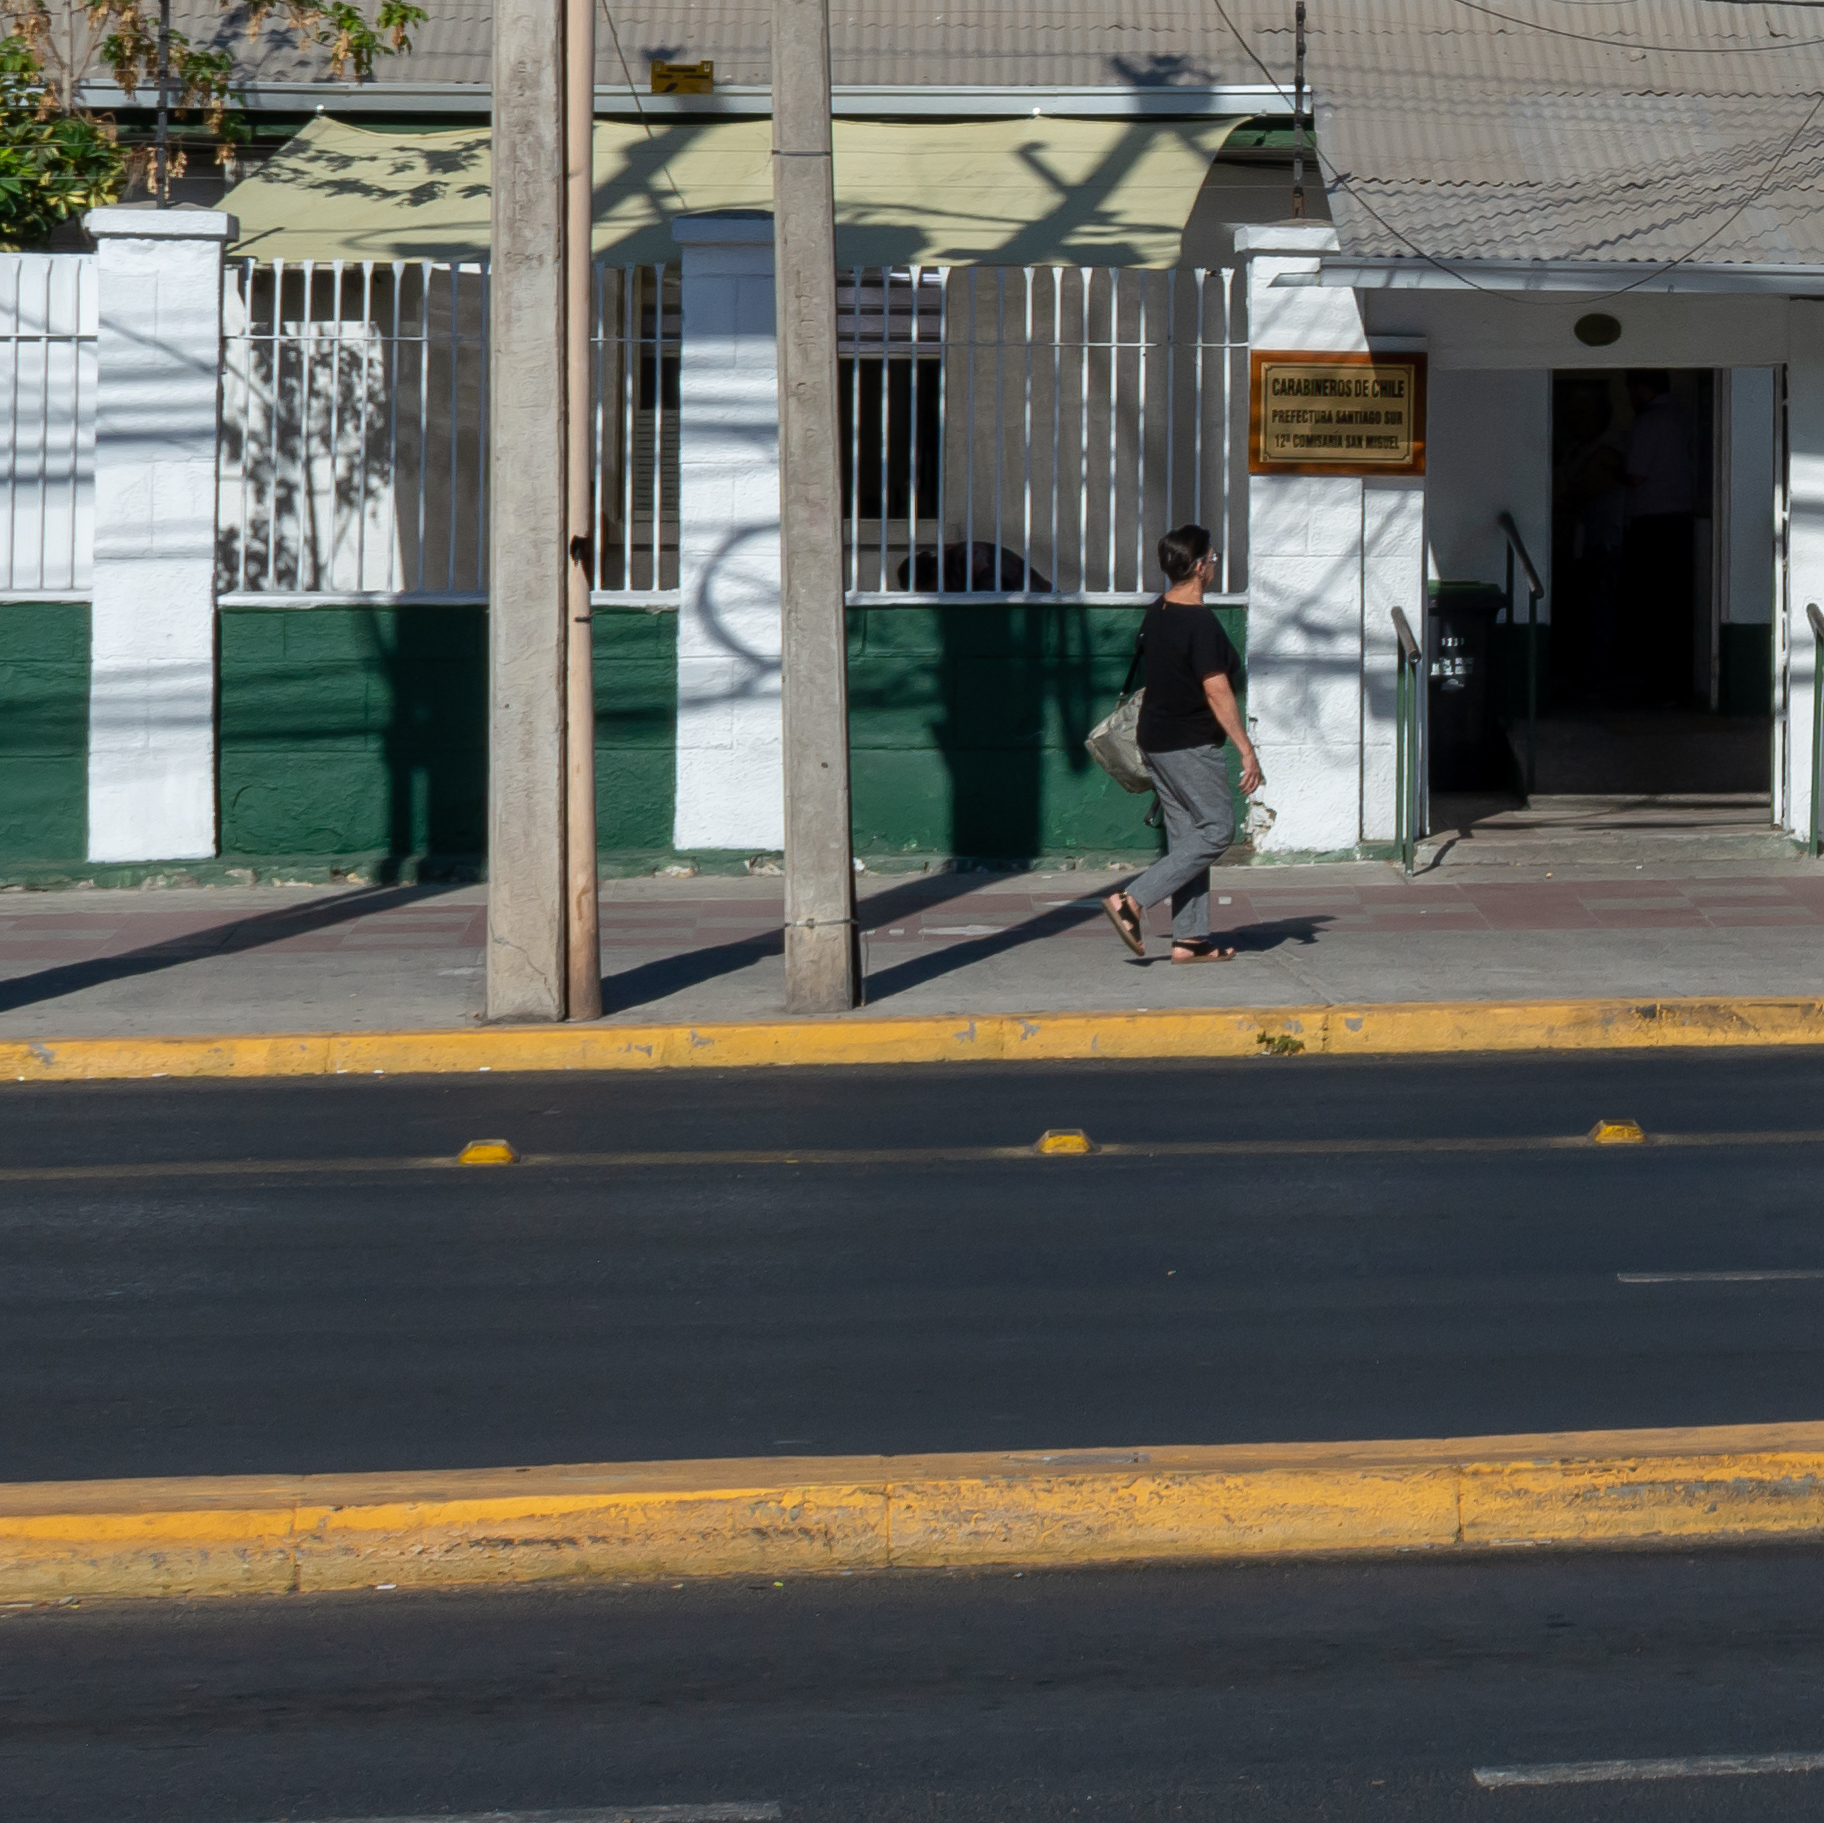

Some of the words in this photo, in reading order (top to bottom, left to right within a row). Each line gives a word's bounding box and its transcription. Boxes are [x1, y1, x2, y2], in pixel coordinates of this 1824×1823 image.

[1271, 378, 1352, 397] CARABINEROS
[1354, 379, 1369, 397] DE
[1371, 379, 1405, 398] CHILE
[1271, 409, 1333, 424] PREFECTURA
[1335, 409, 1382, 425] SANTIAGO
[1383, 411, 1403, 425] SUR
[1345, 434, 1363, 449] SAN
[1365, 434, 1400, 449] MIGUEL
